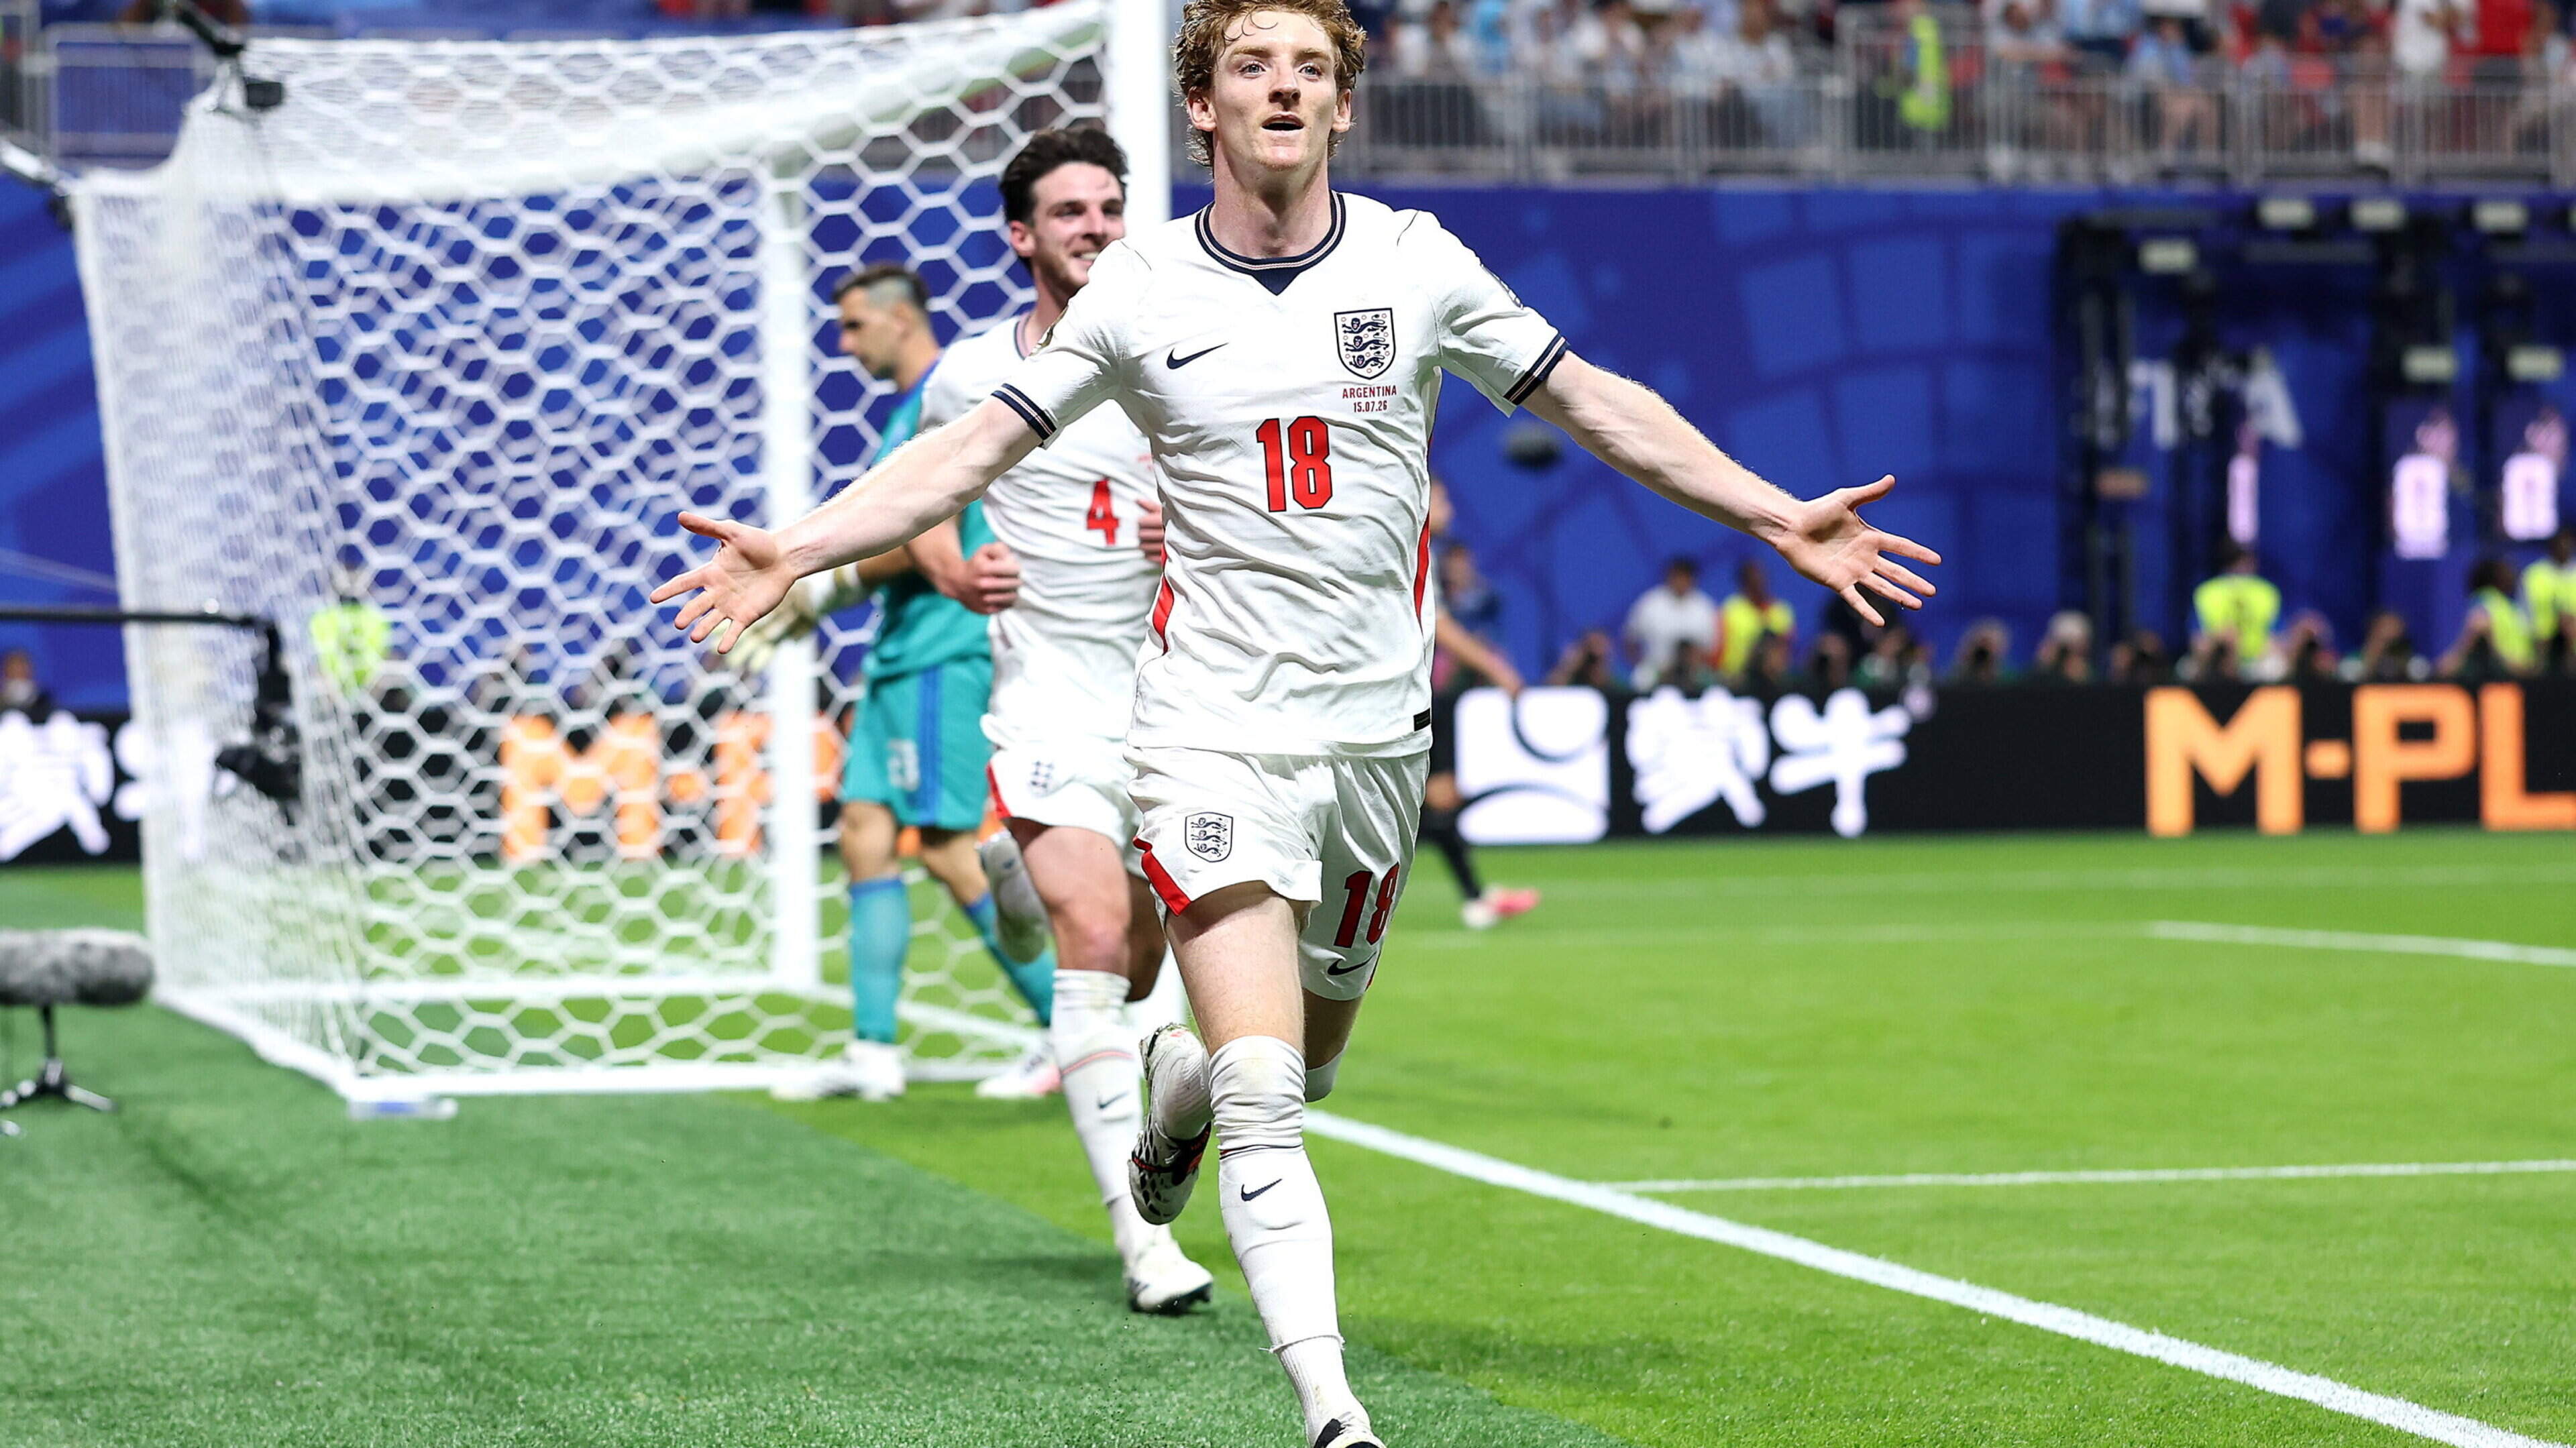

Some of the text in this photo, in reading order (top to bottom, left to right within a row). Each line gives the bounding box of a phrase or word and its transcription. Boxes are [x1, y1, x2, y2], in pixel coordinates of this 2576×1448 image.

[1342, 385, 1397, 398] ARGENTINA
[1353, 400, 1387, 412] 15.07.26
[1256, 416, 1333, 512] 18
[1087, 478, 1120, 545] 4
[2145, 683, 2576, 837] M-PL
[1334, 862, 1400, 948] 18
